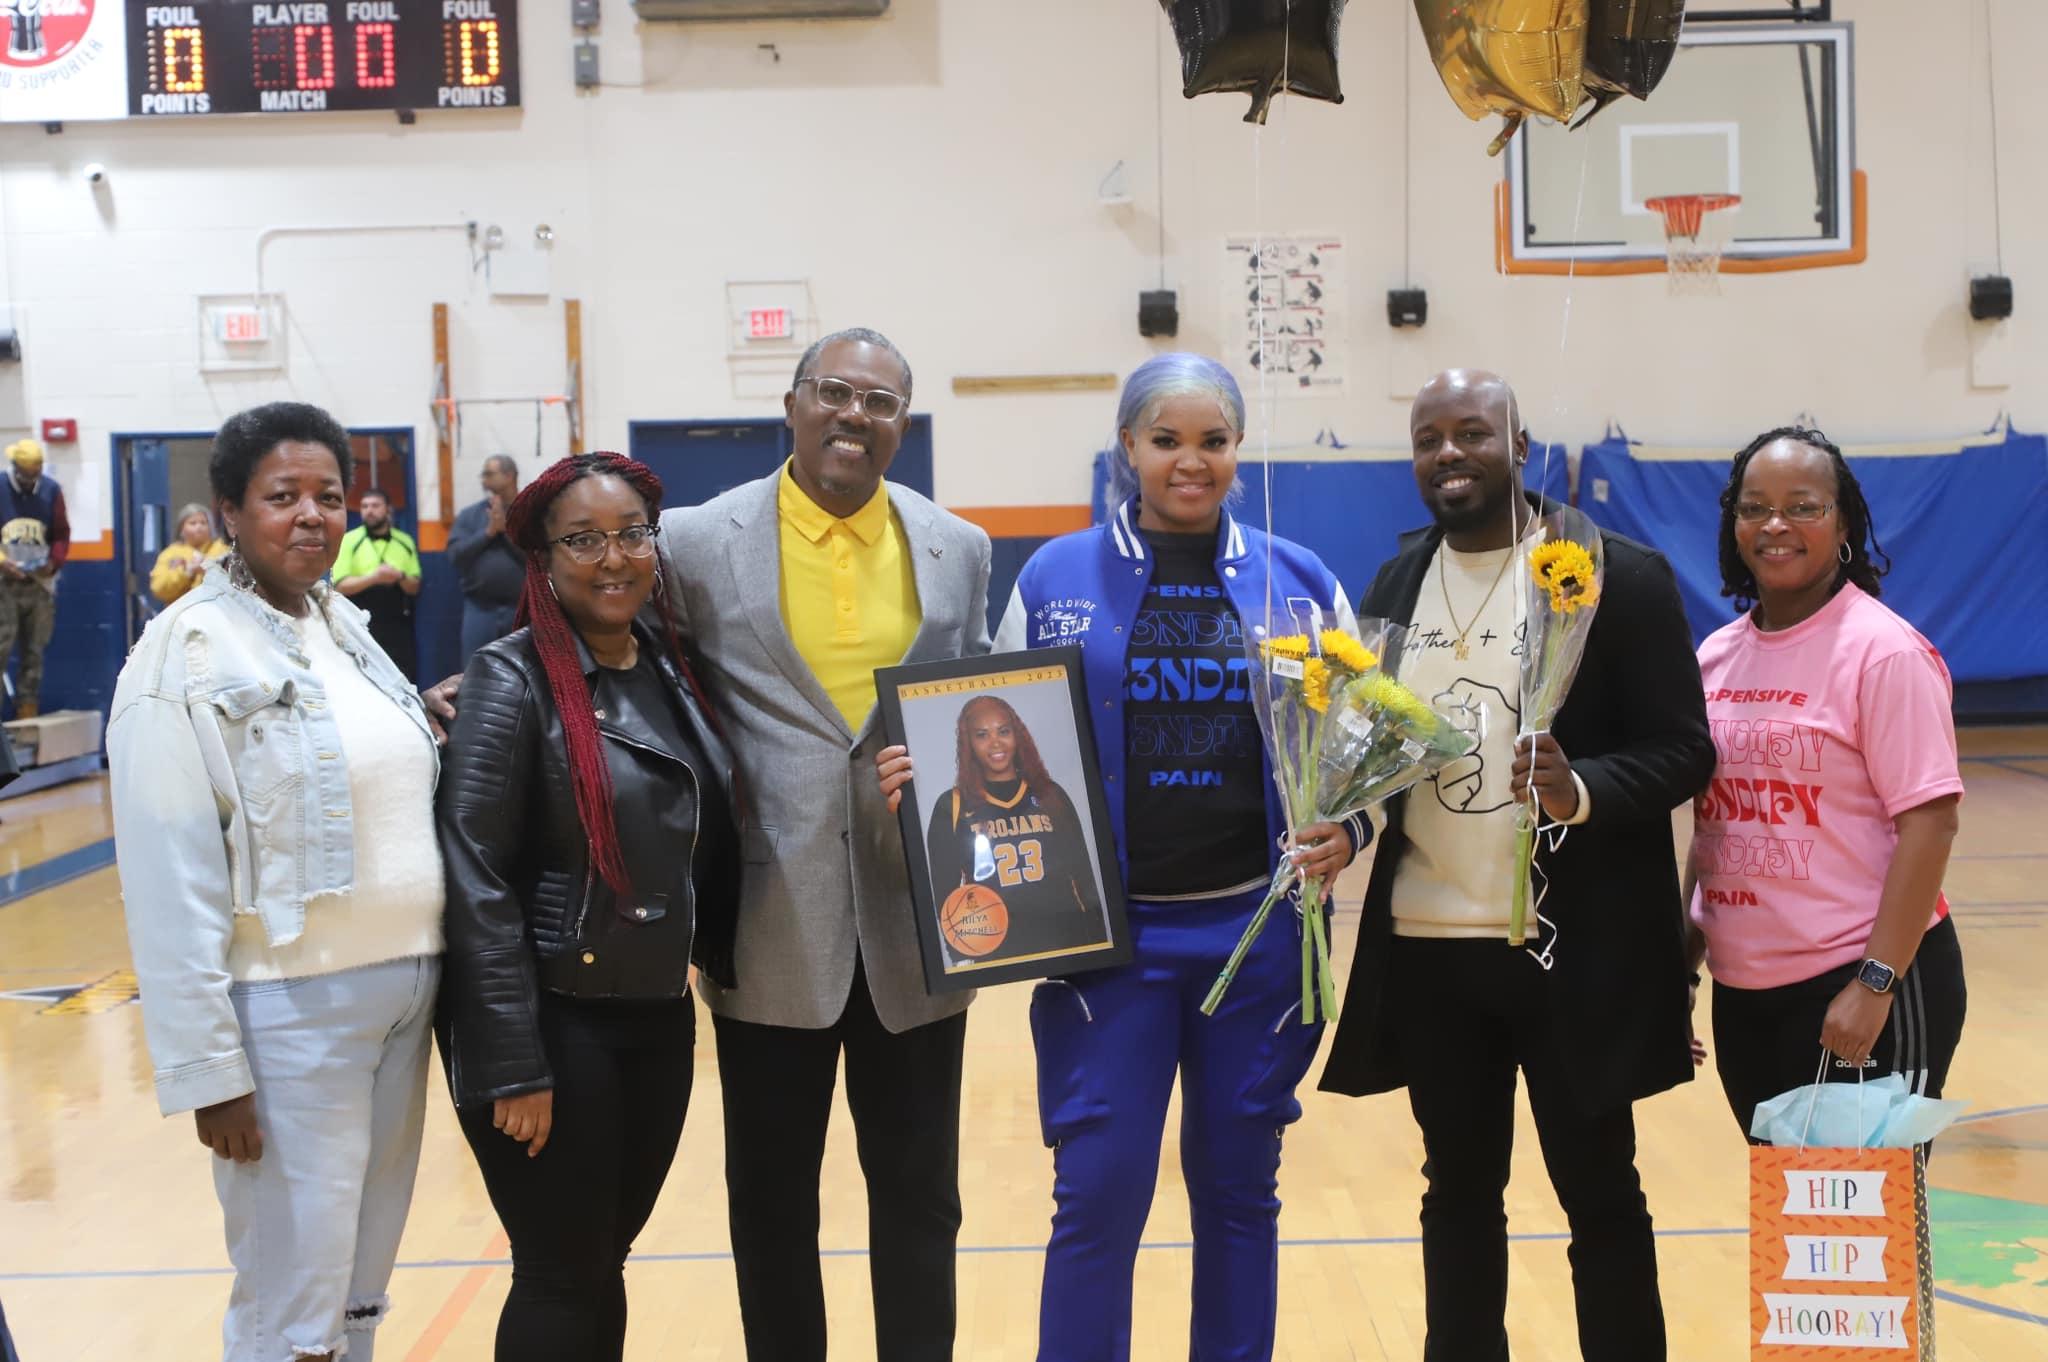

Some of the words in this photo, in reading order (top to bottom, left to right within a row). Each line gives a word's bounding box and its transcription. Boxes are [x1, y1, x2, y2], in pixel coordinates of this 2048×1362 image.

[146, 6, 199, 26] FOUL
[252, 3, 329, 25] PLAYER
[346, 2, 399, 21] FOUL
[442, 0, 496, 19] FOUL
[141, 92, 210, 114] POINTS
[260, 90, 327, 111] MATCH
[438, 86, 506, 107] POINTS
[751, 308, 784, 337] EXIT
[1034, 599, 1096, 619] WORLDWIDE
[1038, 621, 1057, 640] ALL
[1060, 617, 1091, 635] STAR
[901, 678, 1008, 698] BASKETBALL
[1150, 771, 1222, 787] PAIN
[970, 814, 1053, 838] TROJANS
[994, 839, 1044, 887] 23
[1706, 889, 1759, 906] PAIN
[1835, 1057, 1878, 1068] adas
[1808, 1177, 1858, 1210] HIP
[1808, 1241, 1859, 1274] HIP
[1776, 1307, 1896, 1339] HOORAY!
